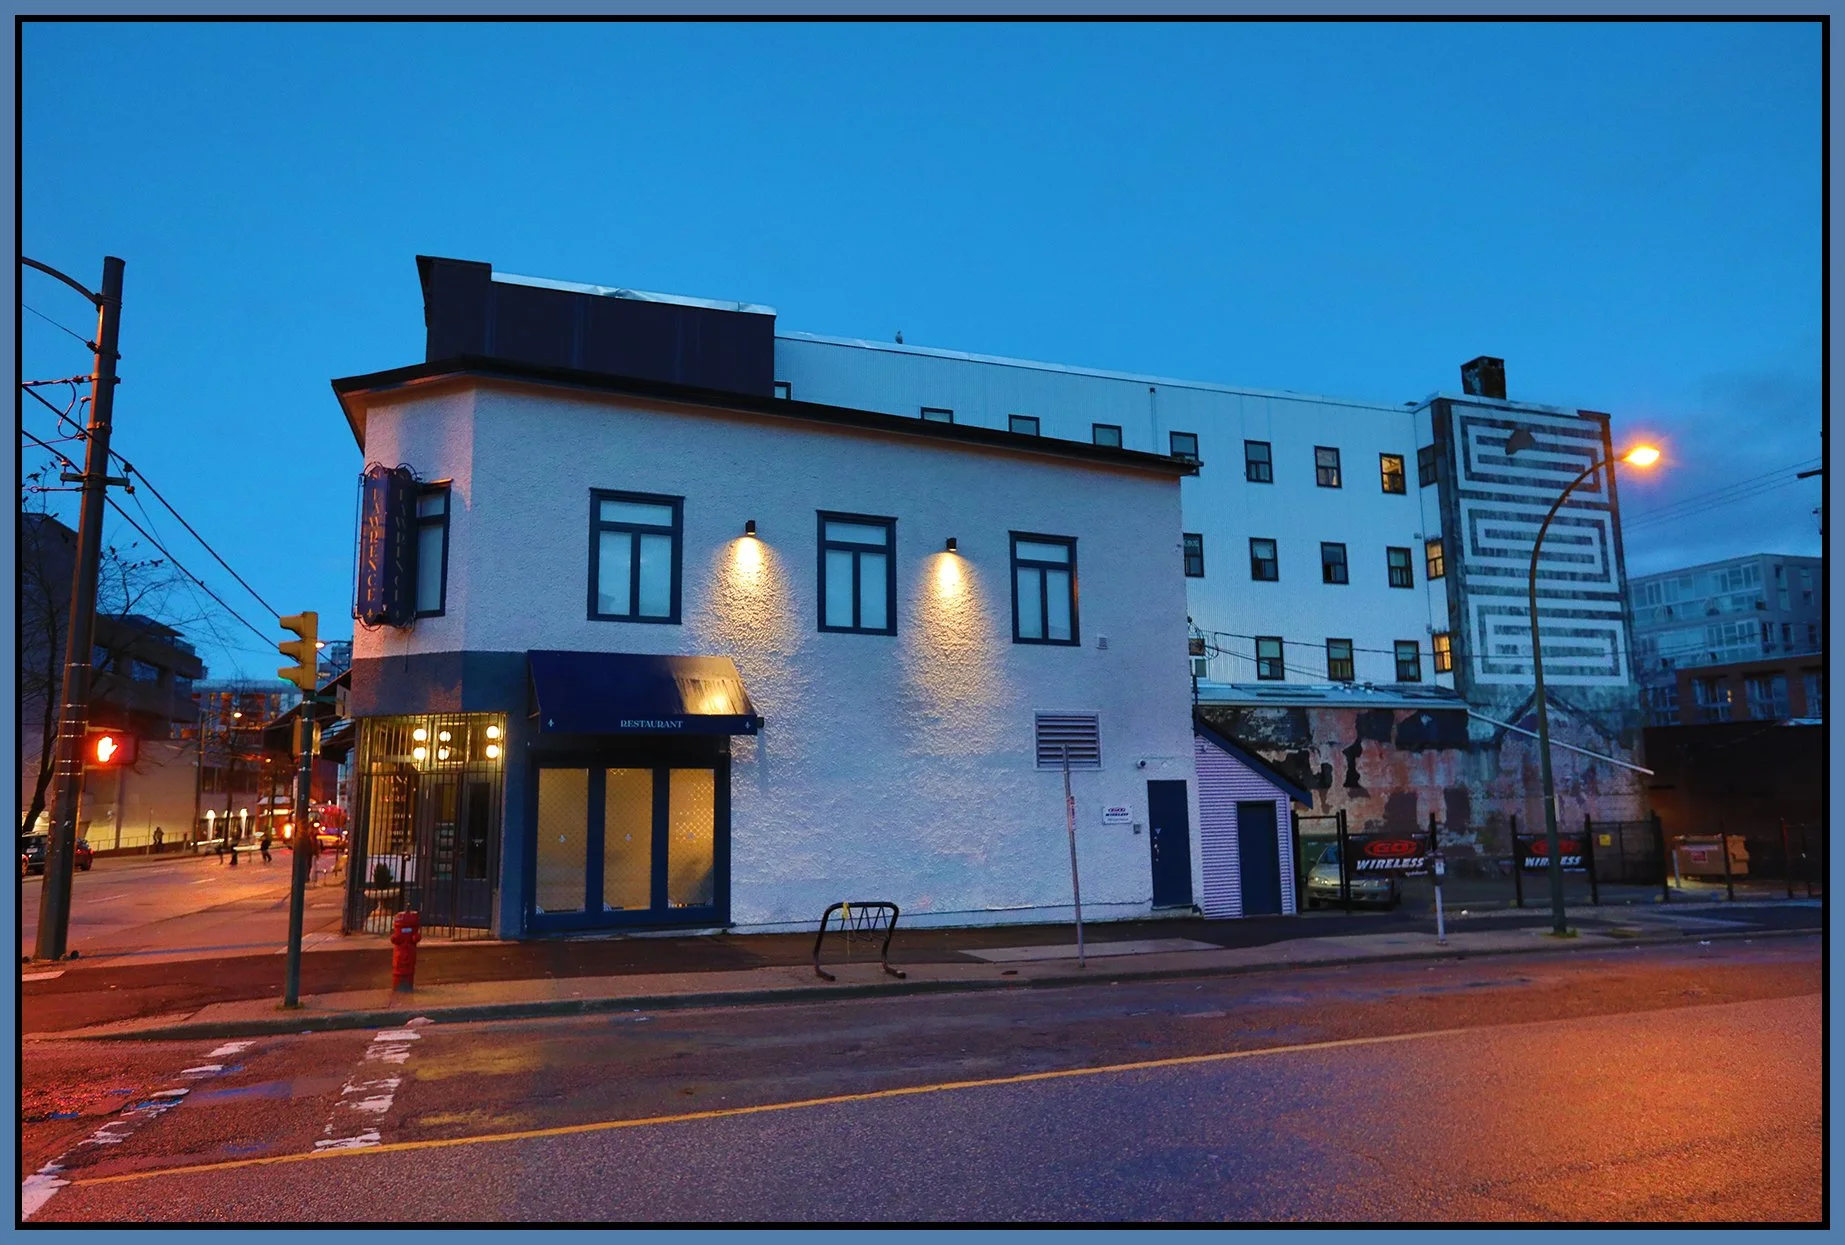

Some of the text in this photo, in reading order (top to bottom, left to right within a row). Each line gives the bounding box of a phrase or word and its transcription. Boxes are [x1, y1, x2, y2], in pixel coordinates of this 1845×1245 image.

[620, 719, 683, 729] RESTAURANT
[1356, 857, 1425, 871] WIRELESS
[1524, 855, 1582, 868] WIRESS
